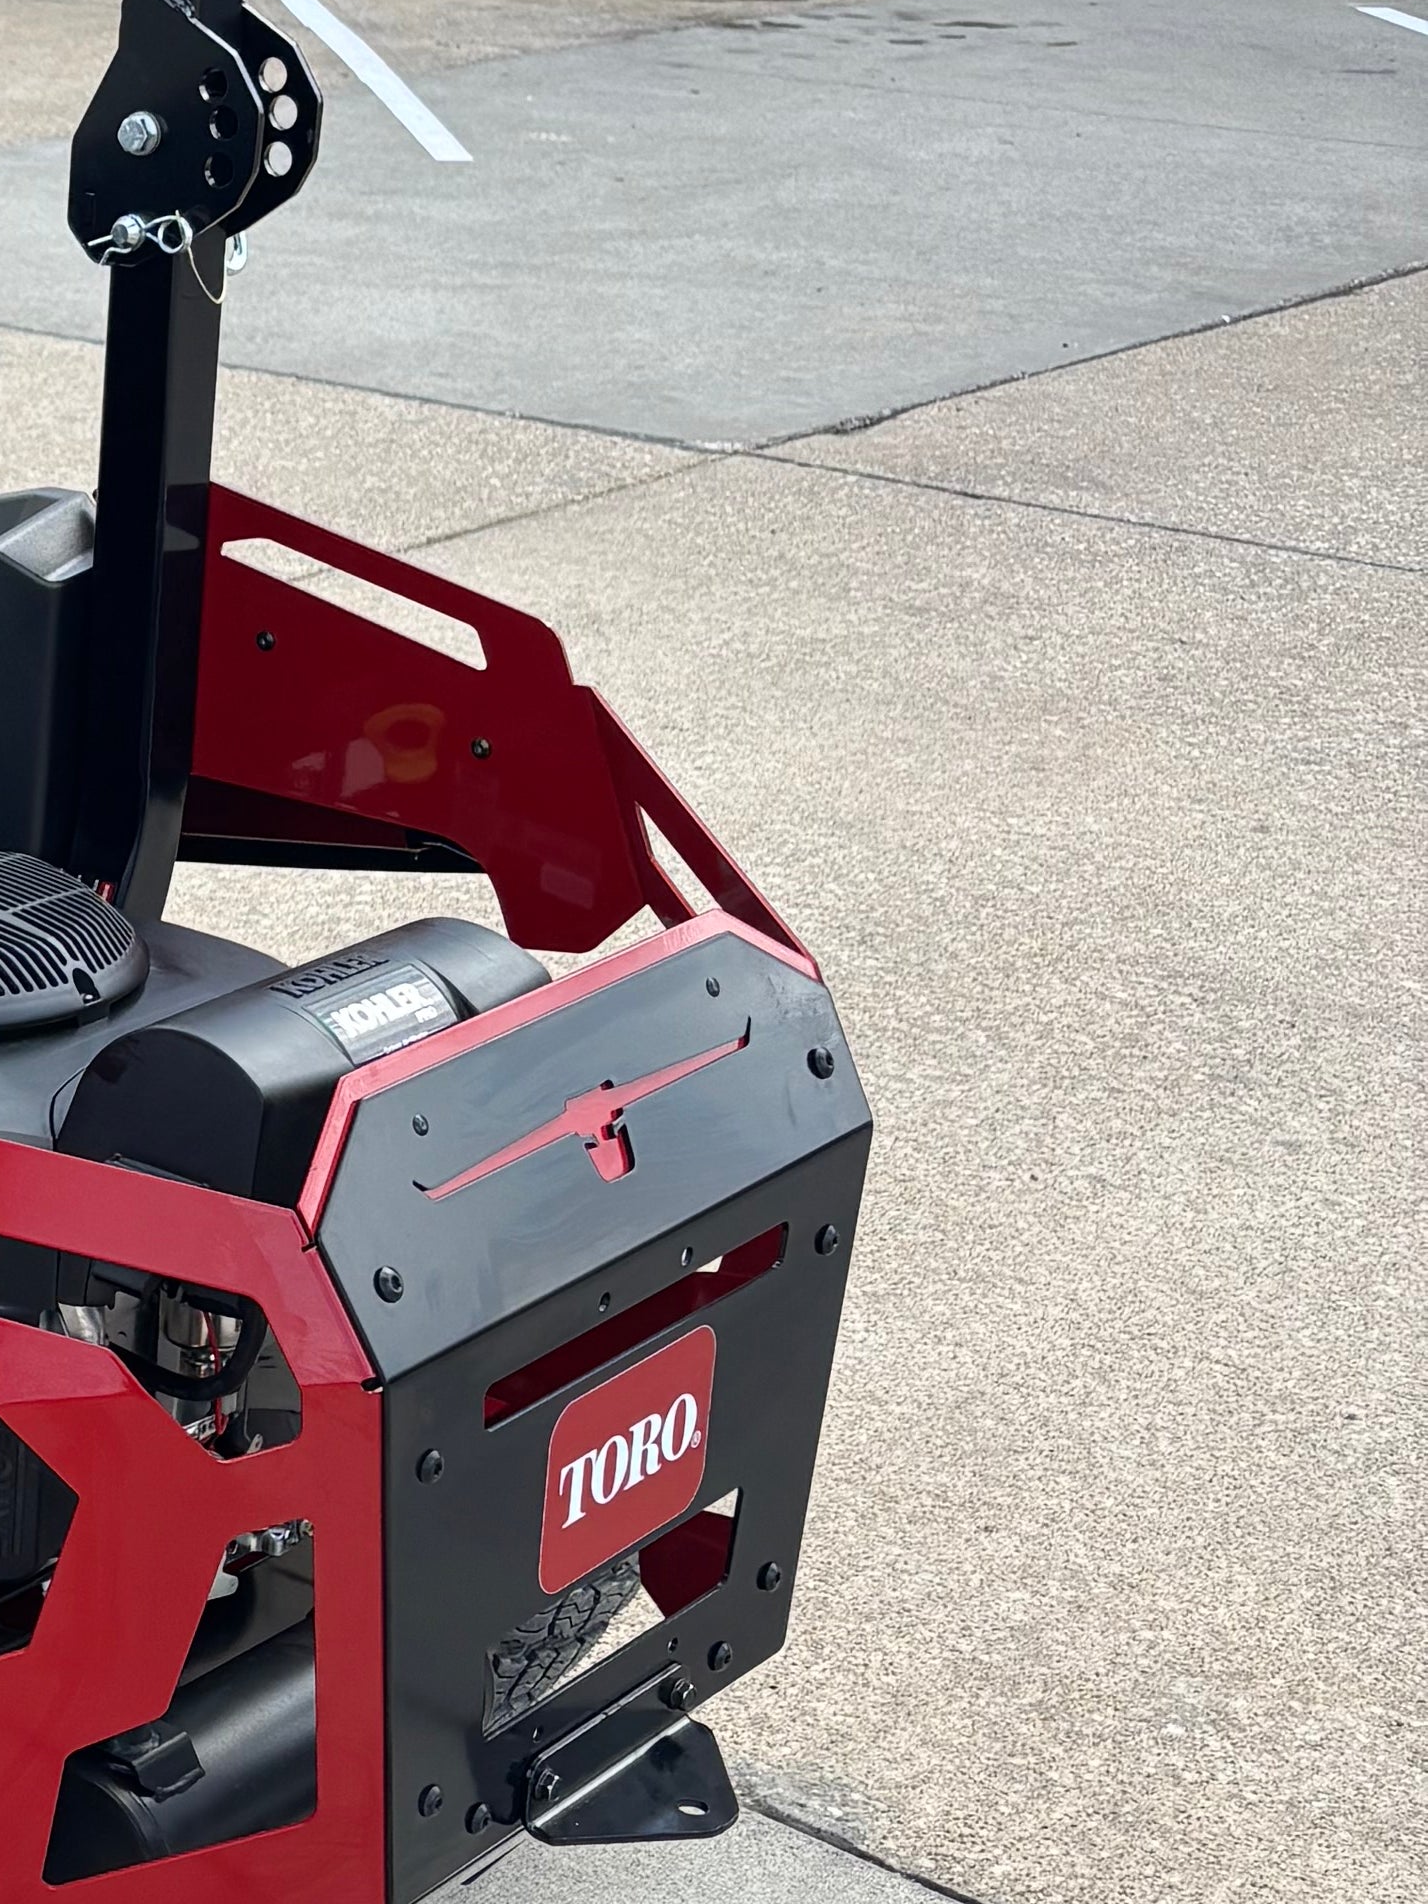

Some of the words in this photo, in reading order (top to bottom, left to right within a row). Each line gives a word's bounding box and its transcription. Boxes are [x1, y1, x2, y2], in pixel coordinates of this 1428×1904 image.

[269, 955, 390, 999] KOHLER
[330, 983, 426, 1039] KOHLER
[558, 1393, 699, 1530] TORO
